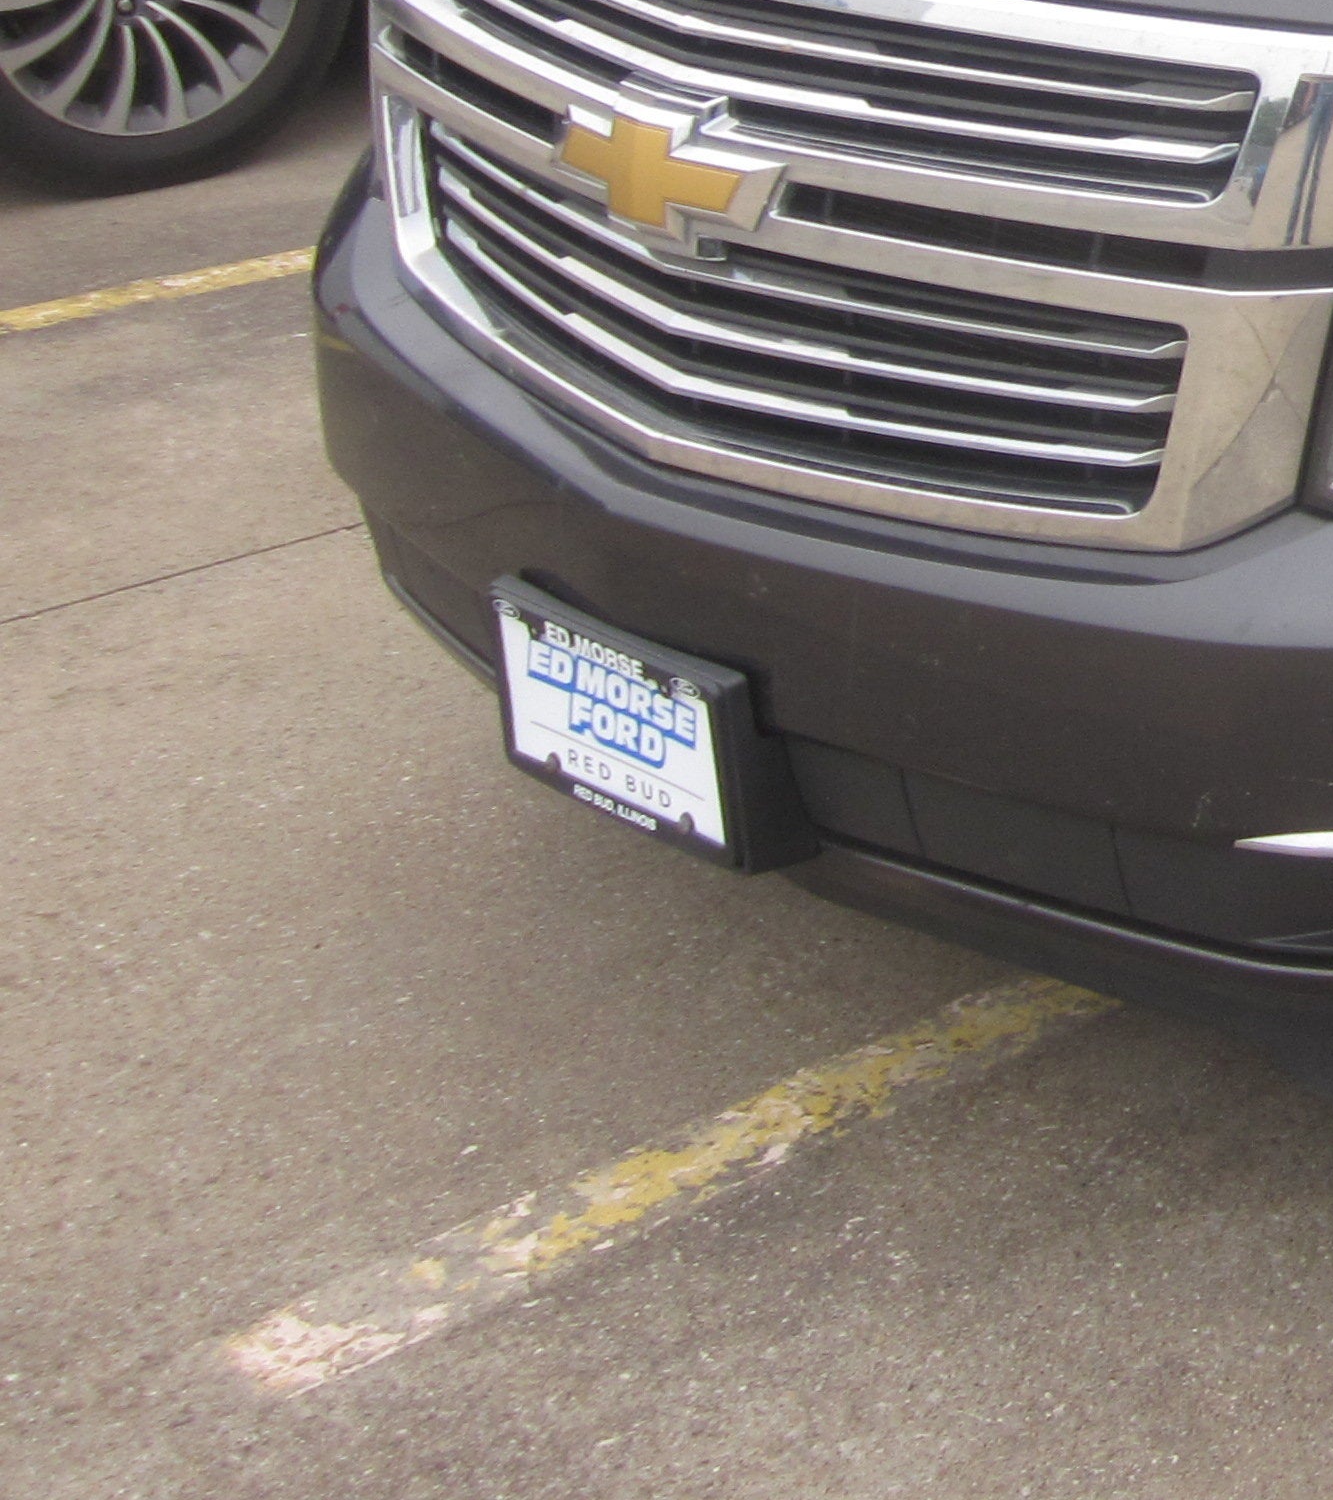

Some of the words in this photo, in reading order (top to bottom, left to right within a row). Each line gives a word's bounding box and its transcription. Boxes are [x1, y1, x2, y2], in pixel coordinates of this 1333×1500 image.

[527, 639, 574, 691] ED
[575, 655, 697, 749] MORSE
[569, 693, 667, 769] FORD
[567, 748, 612, 781] RED
[625, 773, 672, 808] BUD
